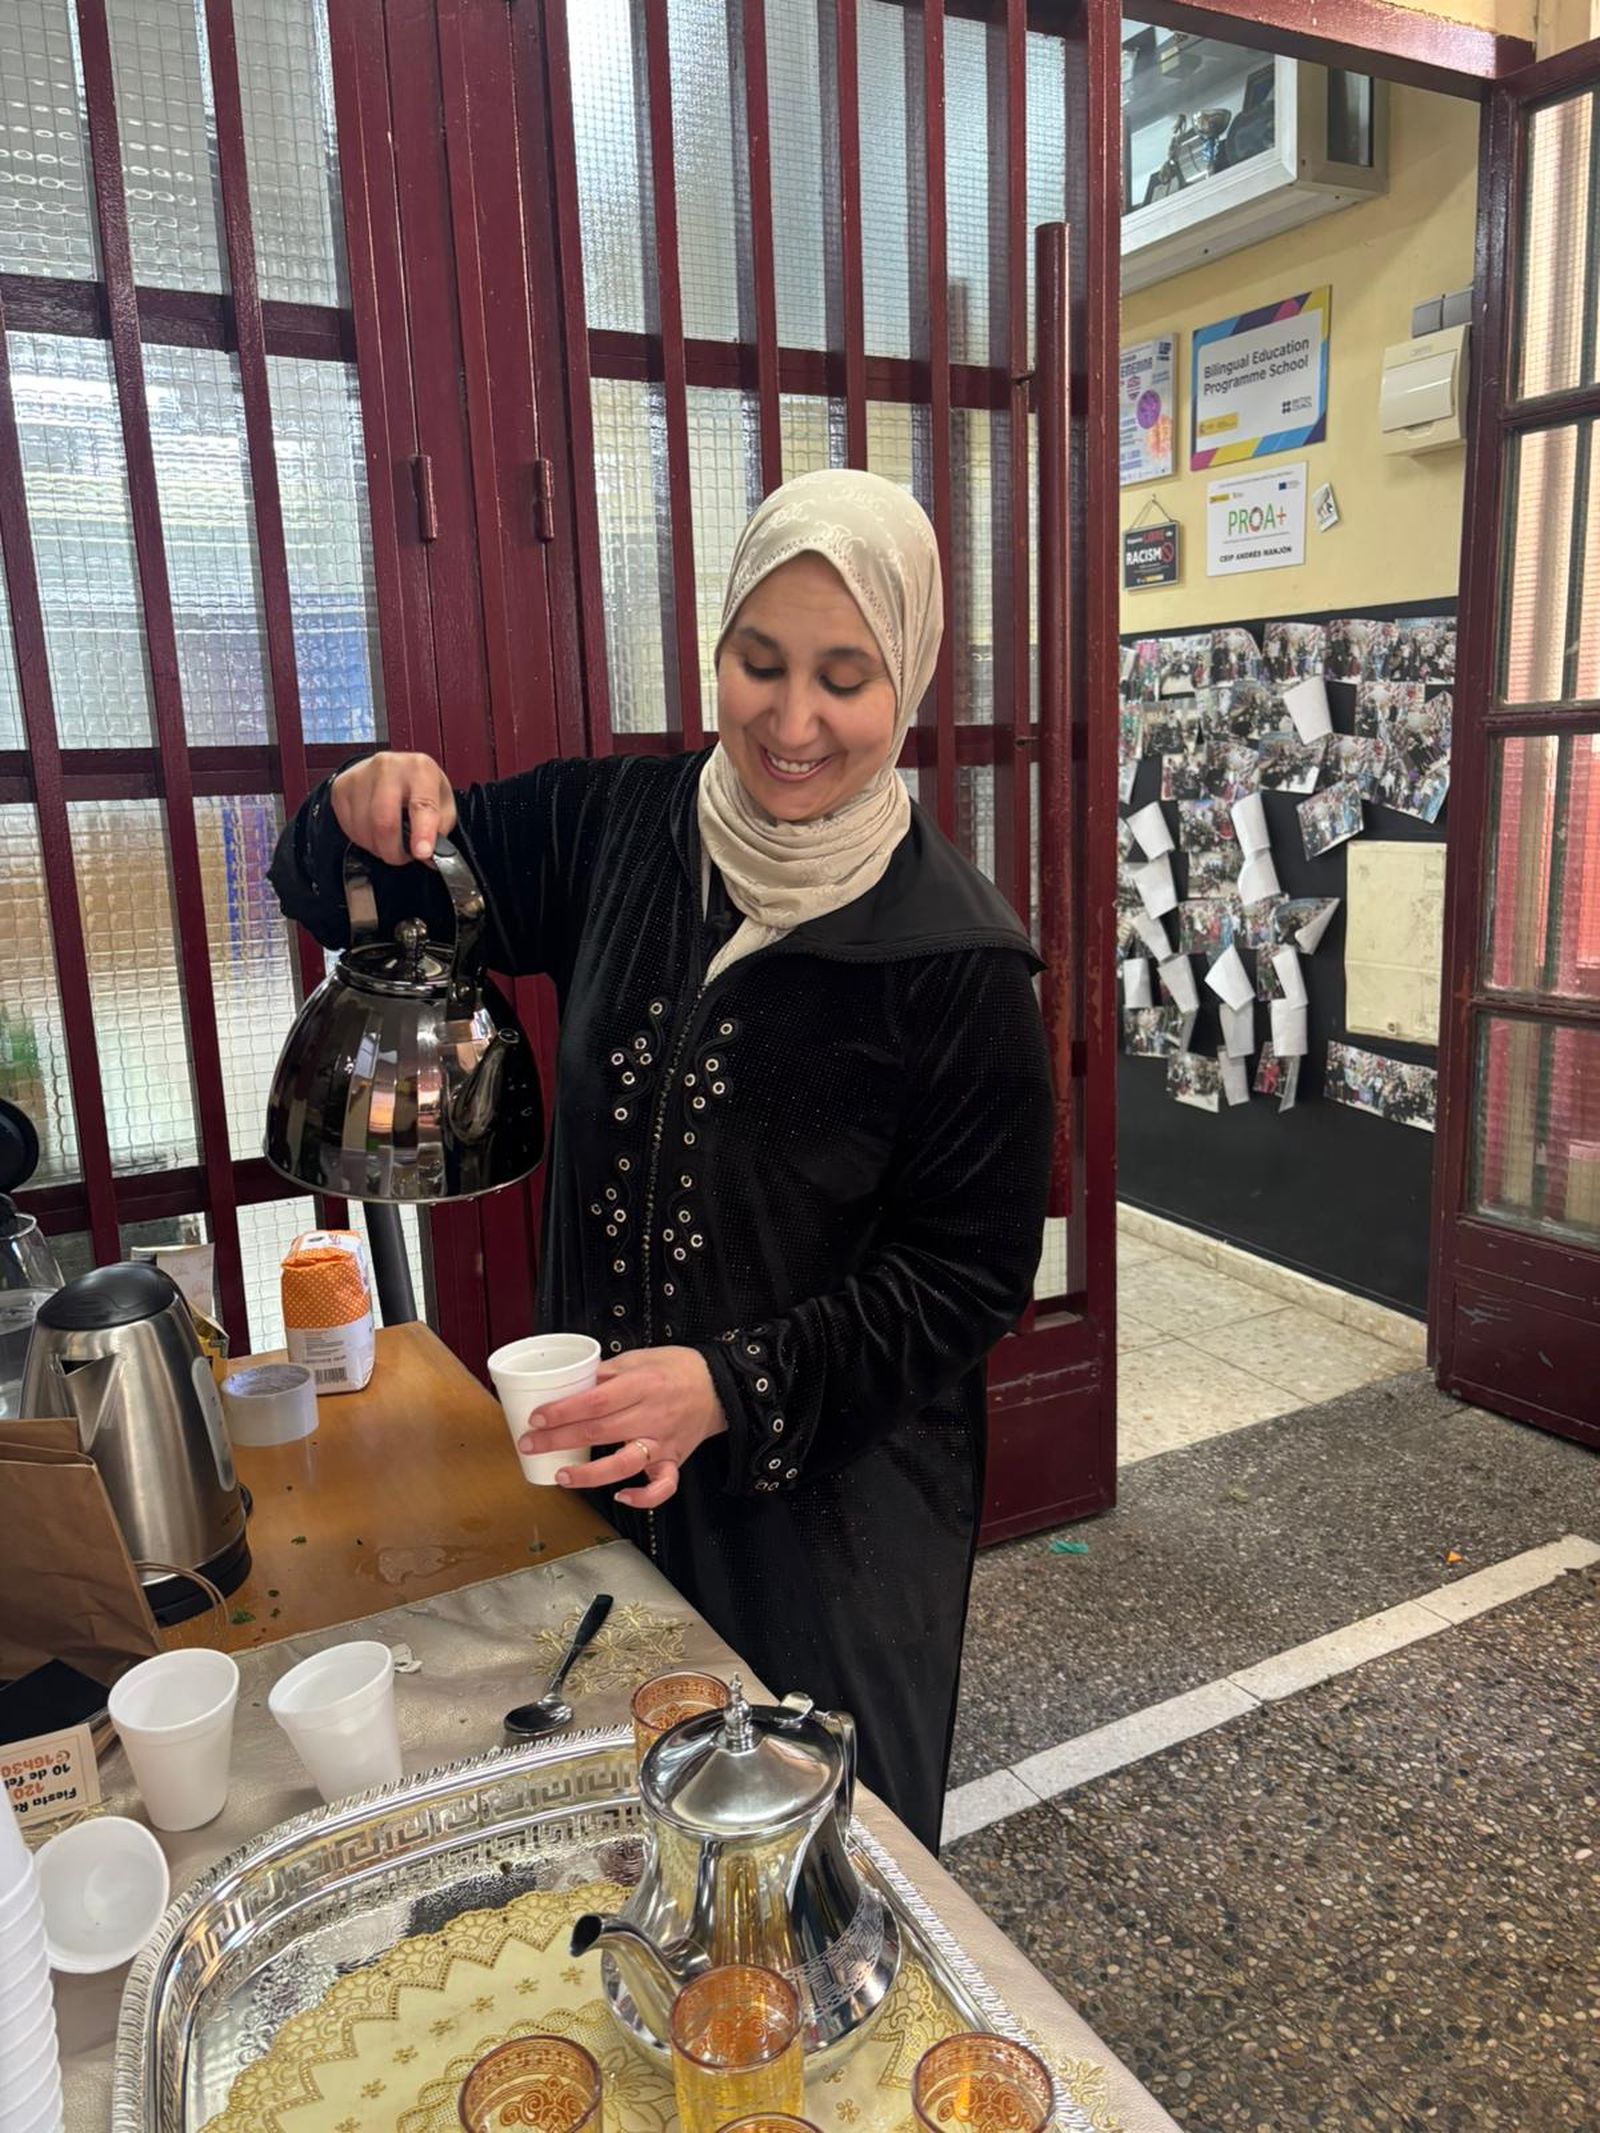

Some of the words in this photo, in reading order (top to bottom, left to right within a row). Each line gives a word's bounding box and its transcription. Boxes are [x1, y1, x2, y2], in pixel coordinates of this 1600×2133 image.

[1204, 354, 1249, 379] Bilingual
[1252, 338, 1309, 365] Education
[1204, 371, 1266, 396] Programme
[1269, 355, 1309, 377] School
[1228, 503, 1287, 536] PROA+
[29, 1768, 47, 1780] de
[52, 1763, 71, 1775] 10
[13, 1782, 45, 1799] 120
[33, 1787, 77, 1806] Fiesta
